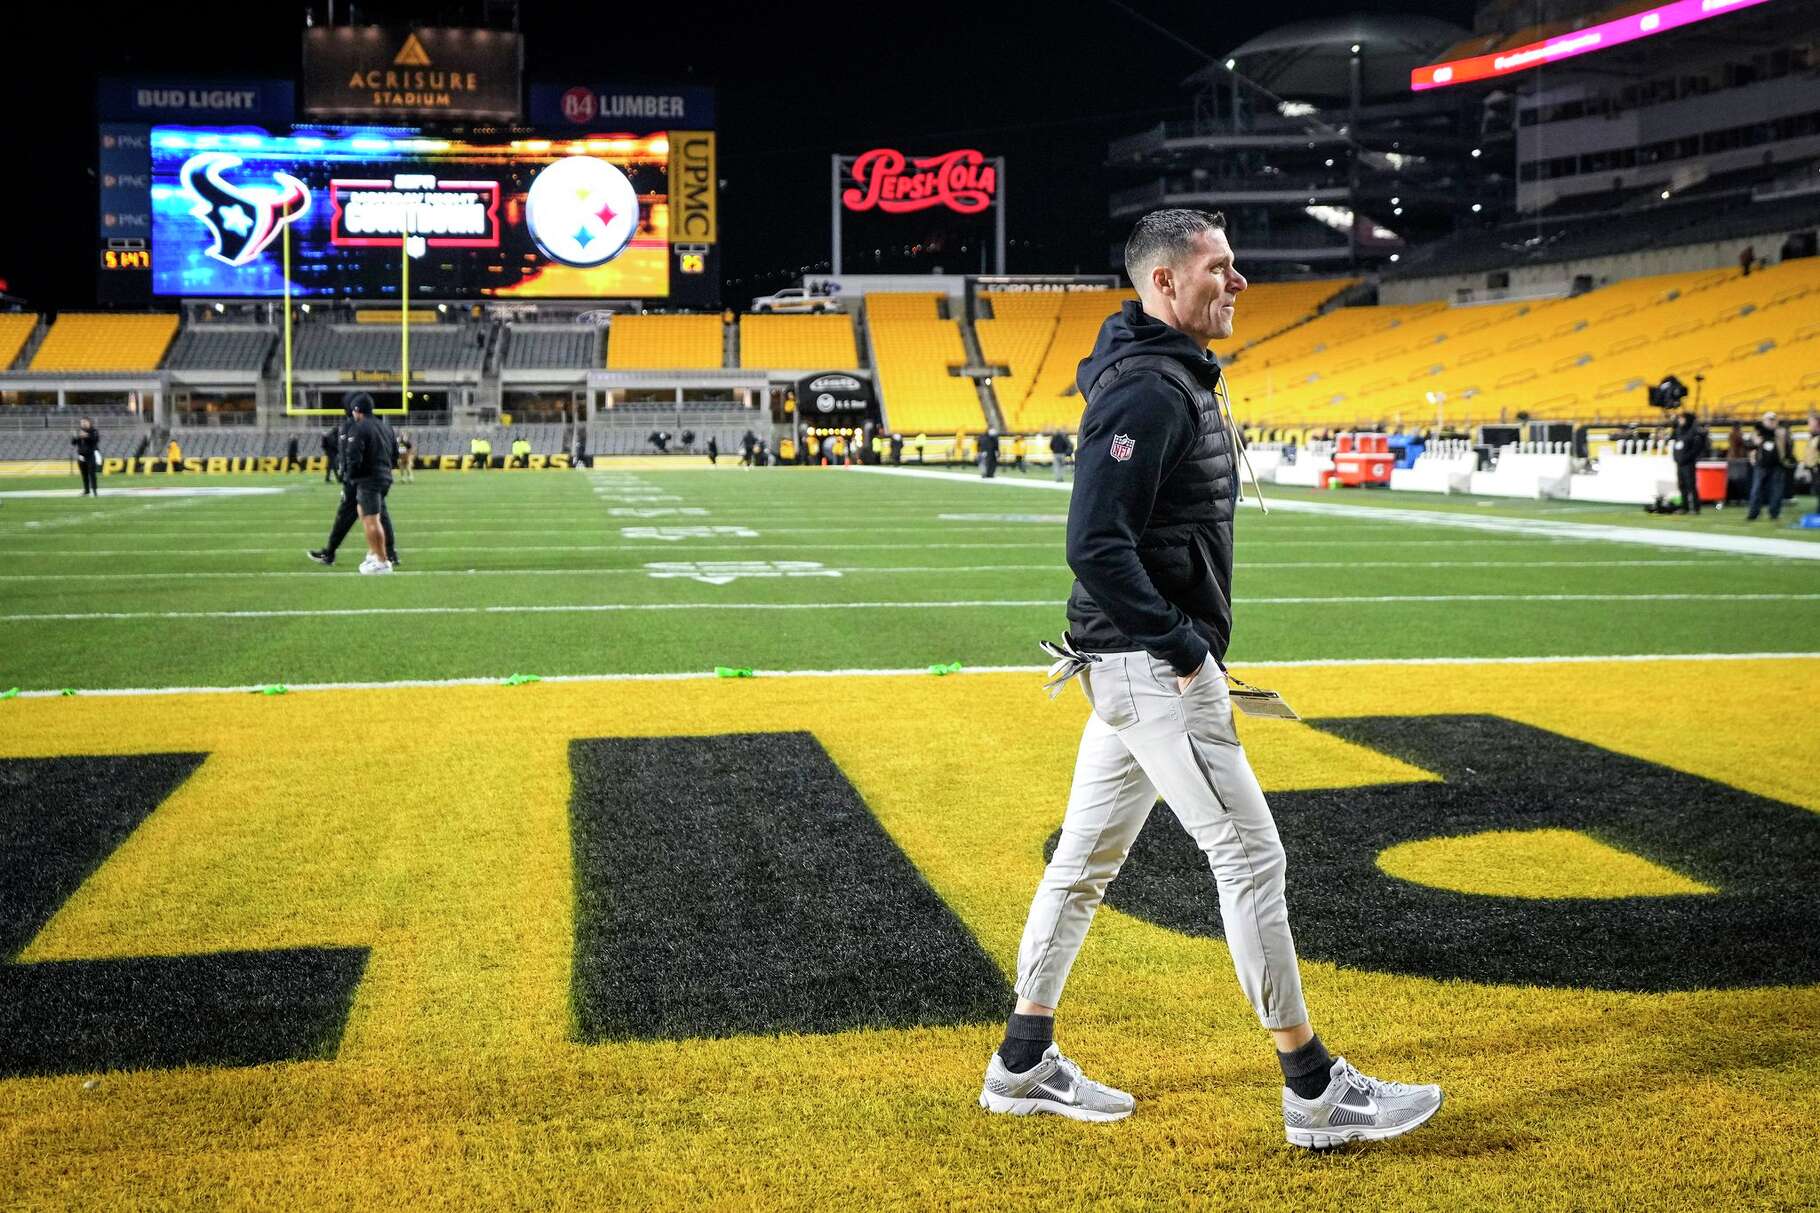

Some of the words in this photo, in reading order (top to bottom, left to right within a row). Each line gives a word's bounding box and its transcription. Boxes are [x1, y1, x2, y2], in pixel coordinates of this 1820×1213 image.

[349, 71, 478, 90] ACRISURE
[136, 90, 186, 108] BUD
[188, 90, 255, 108] LIGHT
[373, 92, 450, 106] STADIUM
[564, 93, 594, 116] 84
[599, 95, 685, 118] LUMBER
[117, 135, 147, 149] PNC
[117, 174, 147, 188] PNC
[684, 138, 710, 237] UPMC
[118, 212, 149, 226] PNC
